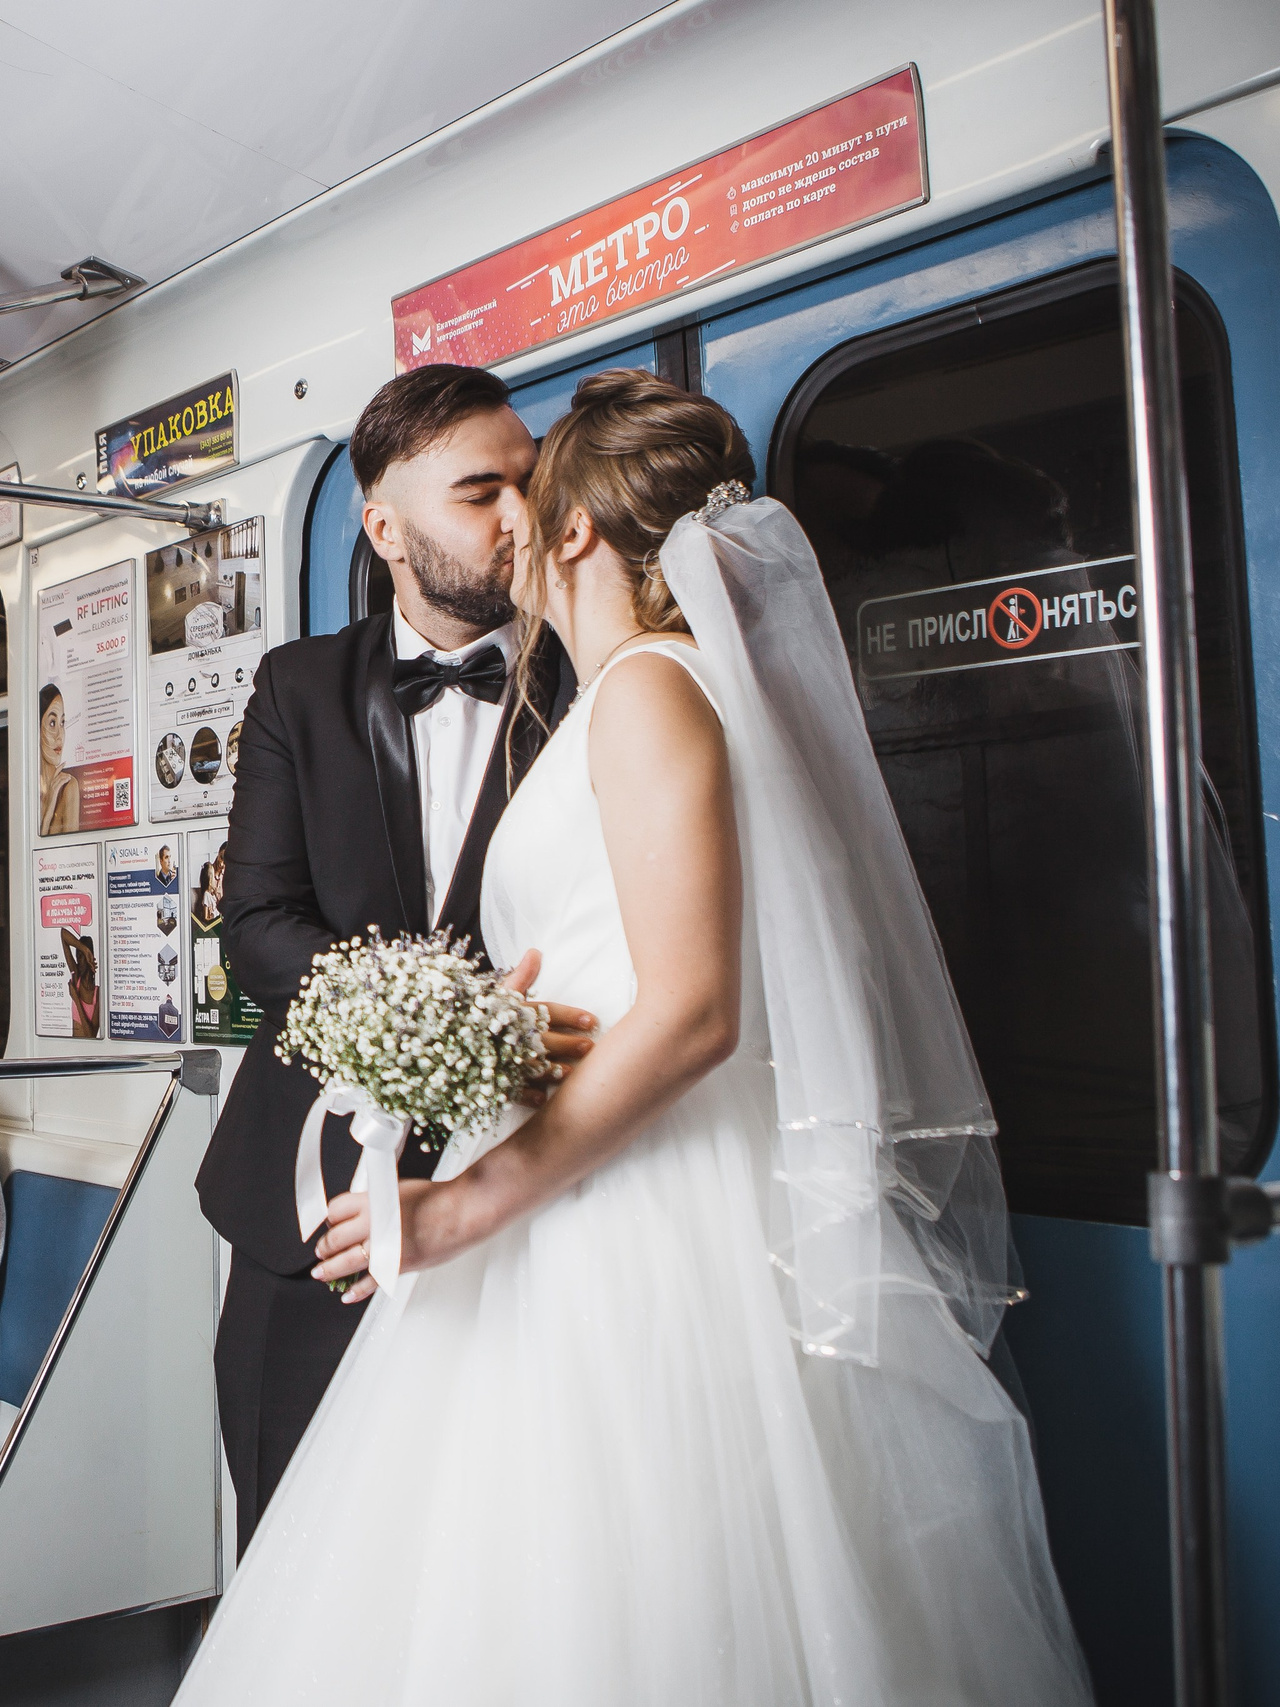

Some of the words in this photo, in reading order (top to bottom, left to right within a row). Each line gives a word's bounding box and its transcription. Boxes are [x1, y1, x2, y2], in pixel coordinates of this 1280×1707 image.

[740, 158, 804, 193] максимум
[805, 152, 820, 167] 20
[821, 136, 863, 160] минут
[864, 130, 874, 142] в
[875, 115, 908, 137] пути
[742, 190, 776, 212] долго
[778, 184, 792, 197] не
[794, 166, 837, 190] ждешь
[838, 147, 880, 171] состав
[743, 204, 784, 228] оплата
[786, 197, 801, 210] по
[802, 182, 837, 206] карте
[548, 195, 691, 307] МЕТРО
[556, 297, 599, 334] это
[605, 245, 691, 304] быстро
[436, 297, 498, 332] Екатеринбургский
[436, 318, 484, 345] метрополитен
[130, 386, 234, 462] УПАКОВКА
[144, 466, 167, 486] любой
[78, 604, 88, 620] RF
[92, 592, 128, 616] LIFTING
[866, 622, 897, 655] НЕ
[907, 584, 1138, 649] ПРИСЛОНЯТЬС
[96, 638, 119, 654] 35.000
[120, 848, 139, 858] SIGNAL
